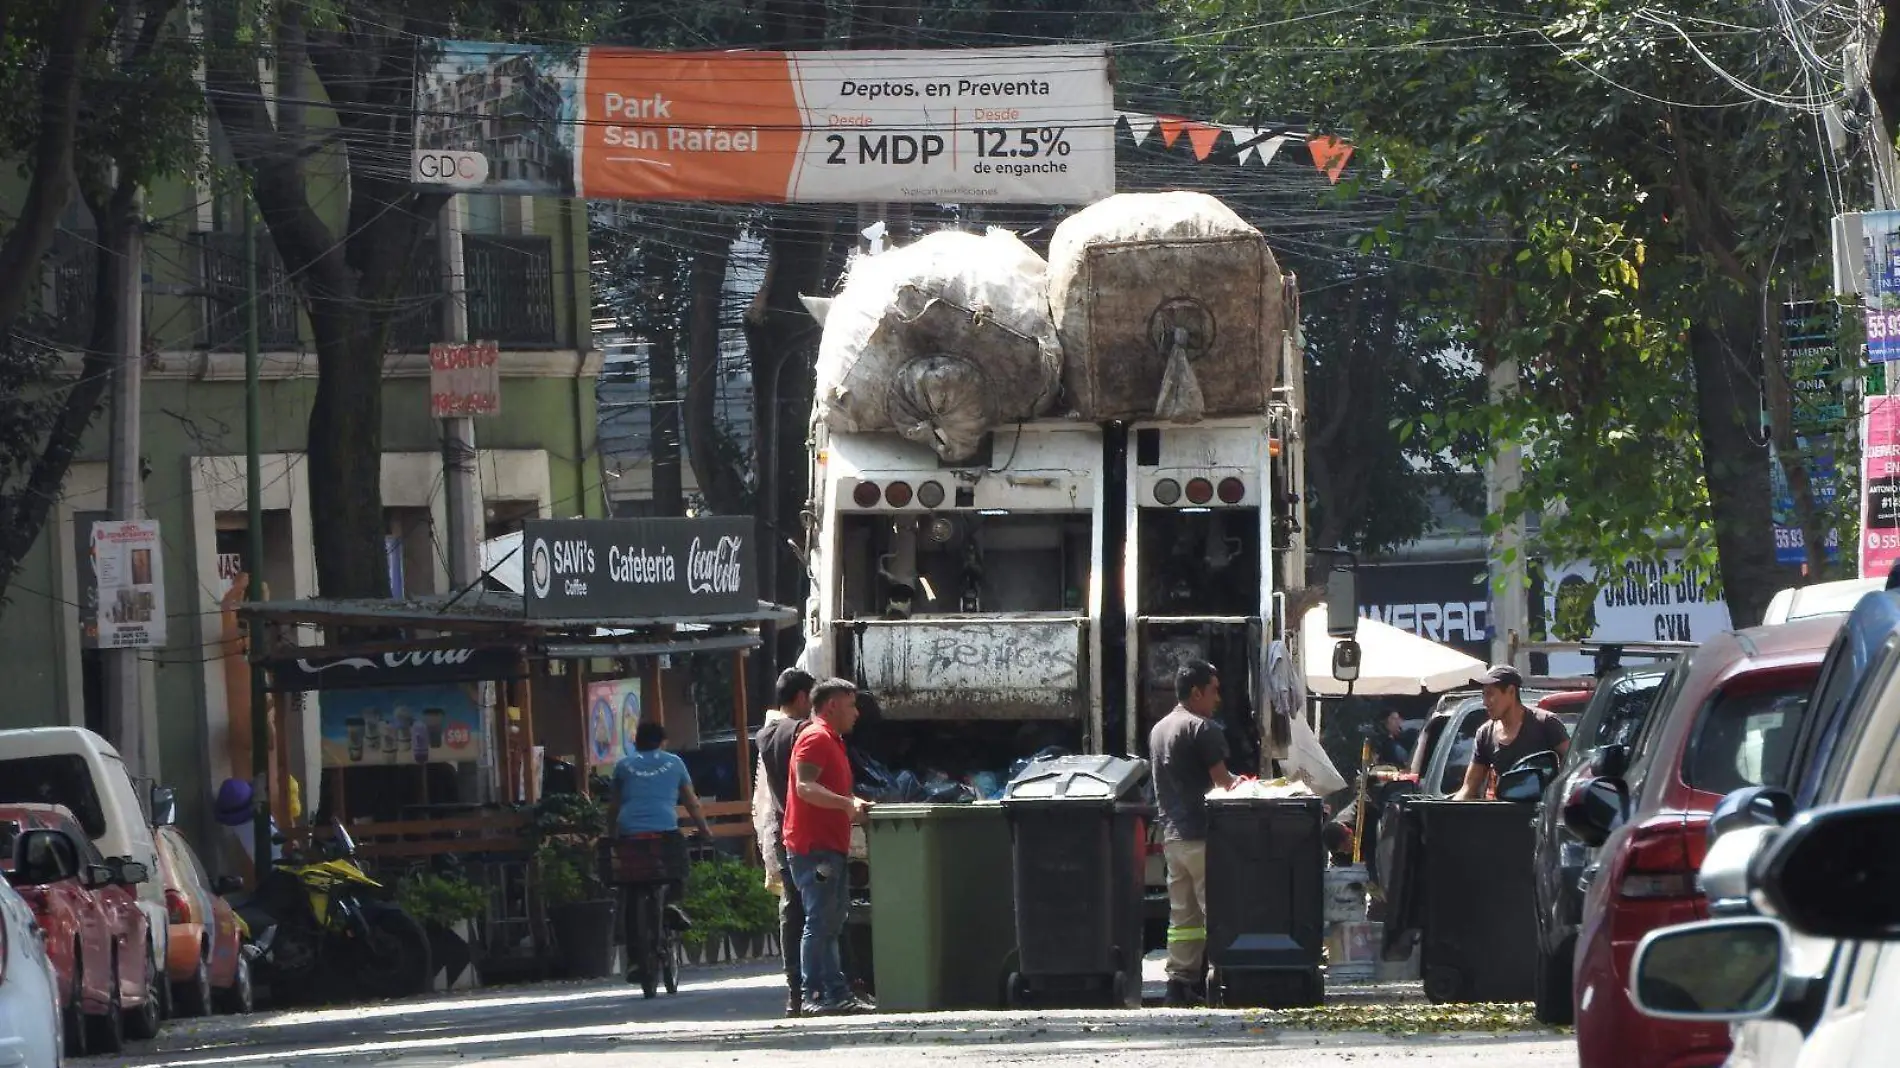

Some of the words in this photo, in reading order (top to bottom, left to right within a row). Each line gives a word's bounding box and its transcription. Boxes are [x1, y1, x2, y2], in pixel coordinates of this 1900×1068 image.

[841, 80, 919, 100] Deptos.
[926, 84, 950, 97] en
[958, 79, 1050, 97] Preventa
[604, 93, 672, 118] Park
[974, 108, 1019, 121] Desde
[828, 113, 873, 127] Desde
[604, 126, 658, 149] San
[668, 126, 757, 151] Rafael
[826, 134, 846, 164] 2
[859, 134, 944, 164] MDP
[973, 127, 1071, 157] 12.5%
[419, 154, 475, 178] GDC
[973, 161, 991, 174] de
[995, 161, 1067, 177] enganche
[1868, 315, 1886, 338] 55
[564, 578, 588, 596] Coffee
[1654, 612, 1691, 642] GYM
